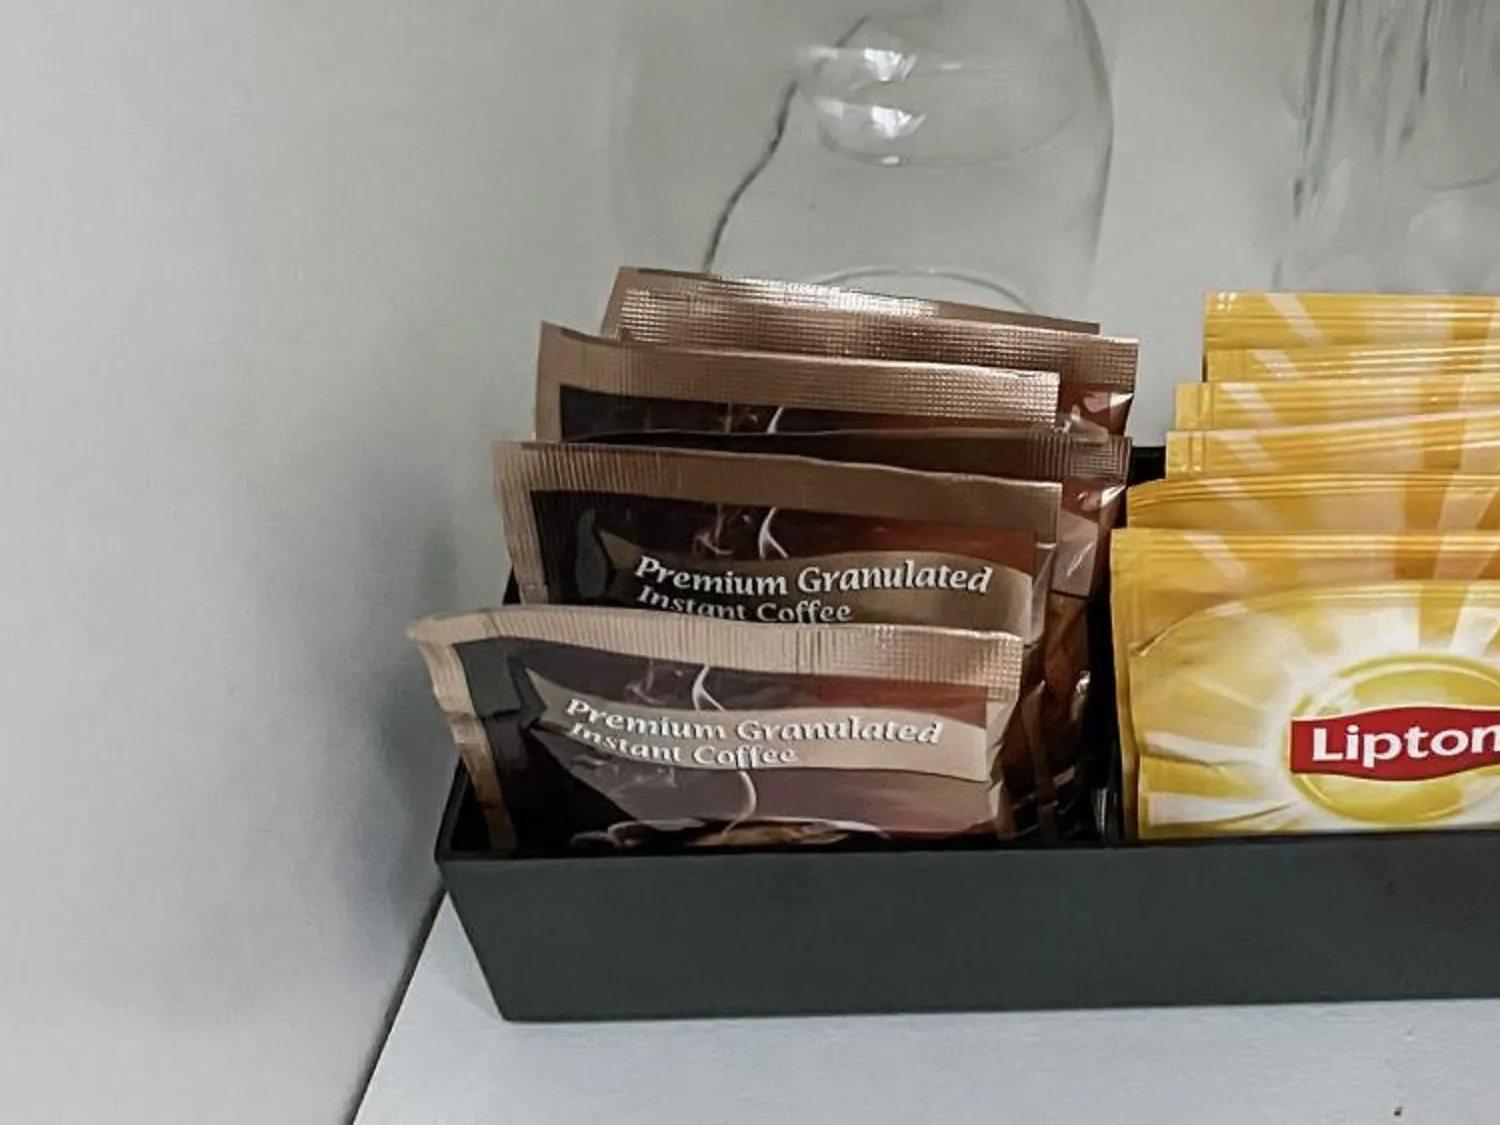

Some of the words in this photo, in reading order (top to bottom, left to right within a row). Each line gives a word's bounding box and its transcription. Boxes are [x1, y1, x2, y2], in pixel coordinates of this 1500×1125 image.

[634, 555, 789, 596] Premium
[797, 559, 993, 594] Granulated
[637, 586, 747, 621] Instant
[756, 600, 852, 625] Coffee
[565, 697, 727, 739] Premium
[736, 715, 944, 745] Granulated
[568, 722, 681, 764] Instant
[692, 744, 798, 768] Coffee
